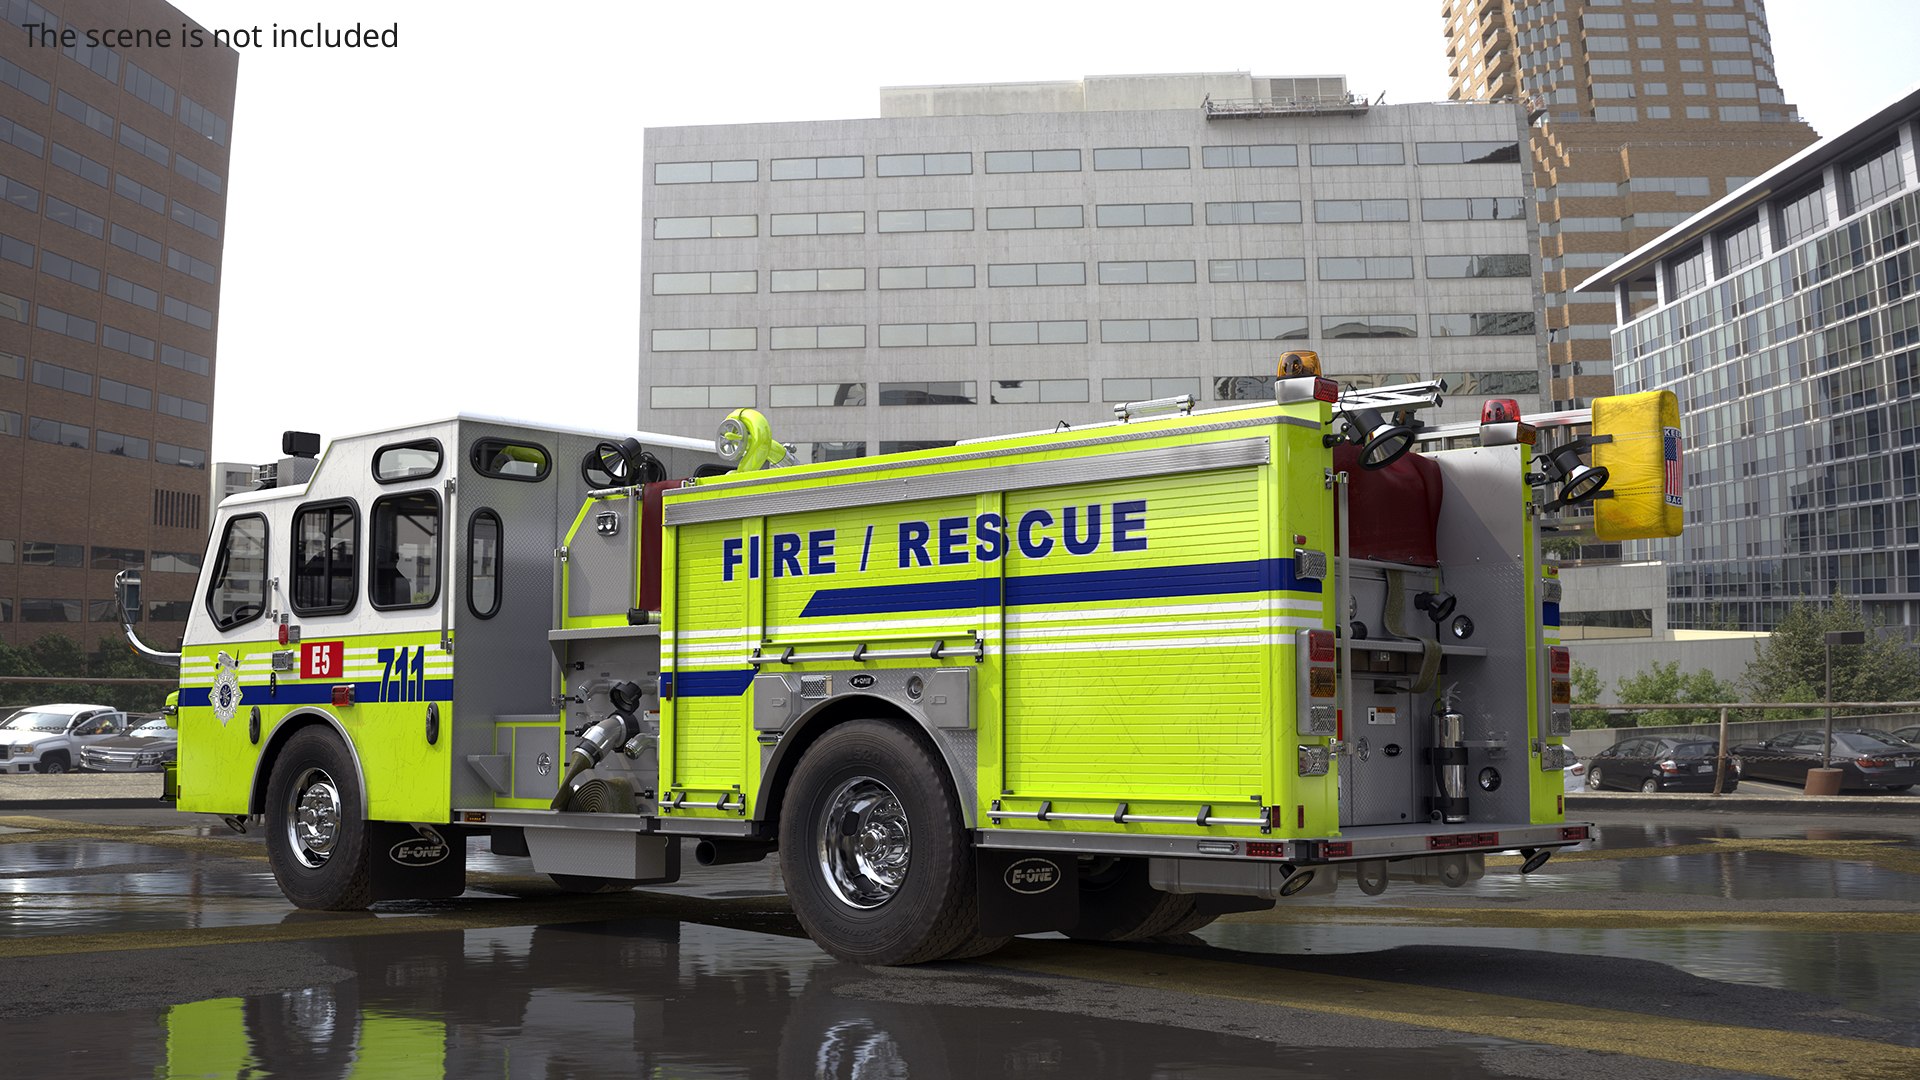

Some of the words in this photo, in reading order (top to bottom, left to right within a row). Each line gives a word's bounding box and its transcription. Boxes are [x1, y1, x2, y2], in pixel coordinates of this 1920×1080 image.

[723, 528, 836, 582] FIRE
[859, 523, 874, 573] /
[898, 498, 1148, 569] RESCUE
[311, 644, 331, 675] E5
[377, 645, 425, 703] 711
[397, 845, 442, 859] E-ONE
[1012, 867, 1054, 884] E-ONE
